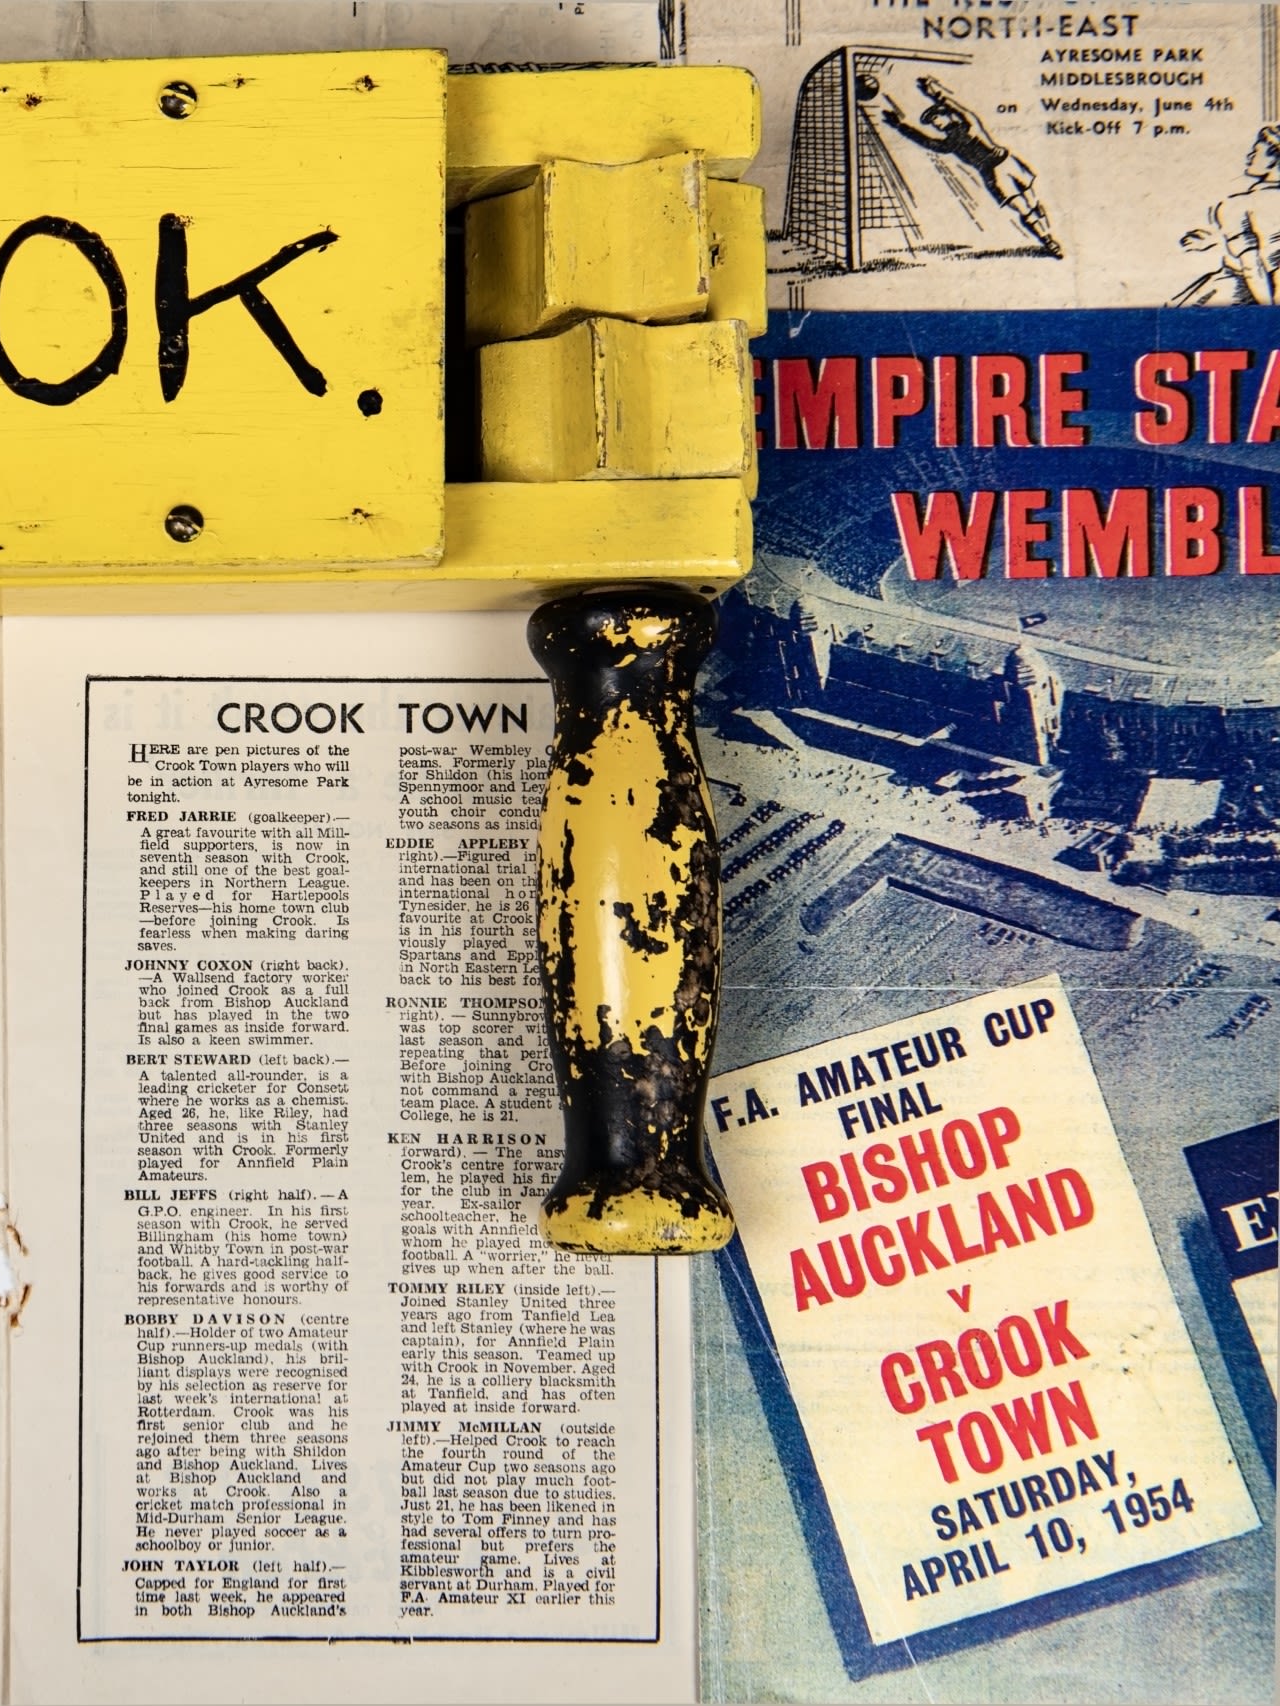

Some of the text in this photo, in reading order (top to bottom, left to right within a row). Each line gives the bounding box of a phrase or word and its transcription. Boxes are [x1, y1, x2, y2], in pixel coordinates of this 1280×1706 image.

[922, 14, 1140, 40] NORTH-EAST
[1040, 47, 1203, 63] AYRESOME PARK
[1040, 71, 1204, 87] MIDDLESBROUGH
[996, 96, 1234, 118] on Wednesday, June 4th
[1046, 120, 1190, 138] Kick-Off 7 p.m.
[753, 353, 1087, 449] MPIRE
[216, 702, 528, 735] CROOK TOWN
[129, 743, 350, 763] HERE are pen pictures of the
[154, 759, 350, 774] Crook Town players who will
[127, 775, 350, 789] be in action at Ayresome Park
[126, 791, 181, 805] tonight.
[126, 810, 169, 822] FRED
[178, 810, 237, 822] JARRIE
[385, 837, 530, 850] EDDIE APPLEBY
[124, 959, 189, 971] JOHNNY
[196, 959, 253, 972] COXON
[260, 959, 301, 972] (right
[385, 996, 448, 1009] RONNIE
[126, 1054, 168, 1066] BERT
[173, 1053, 252, 1066] STEWARD
[258, 1053, 289, 1066] (left
[710, 998, 1057, 1132] F.A. AMATEUR CUP
[838, 1085, 943, 1140] FINAL
[387, 1132, 547, 1146] KEN HARRISON
[801, 1107, 1021, 1224] BISHOP
[123, 1189, 161, 1201] BILL
[169, 1189, 217, 1201] JEFFS
[228, 1188, 269, 1203] (right
[789, 1167, 1096, 1312] AUCKLAND
[401, 1261, 614, 1277] gives up when after the ball.
[387, 1282, 449, 1295] TOMMY
[456, 1283, 505, 1295] RILEY
[513, 1283, 560, 1296] (inside
[124, 1313, 179, 1326] BOBBY
[300, 1313, 350, 1326] (centre
[880, 1300, 1091, 1415] CROOK
[386, 1420, 616, 1435] JIMMY McMILLAN (outside
[916, 1380, 1100, 1484] TOWN
[135, 1471, 347, 1486] at Bishop Auckland and
[931, 1450, 1137, 1541] SATURDAY,
[901, 1478, 1195, 1601] APRIL 10, 1954
[121, 1559, 164, 1572] JOHN
[174, 1559, 240, 1572] TAYLOR
[252, 1559, 283, 1574] (left
[400, 1606, 434, 1619] year.
